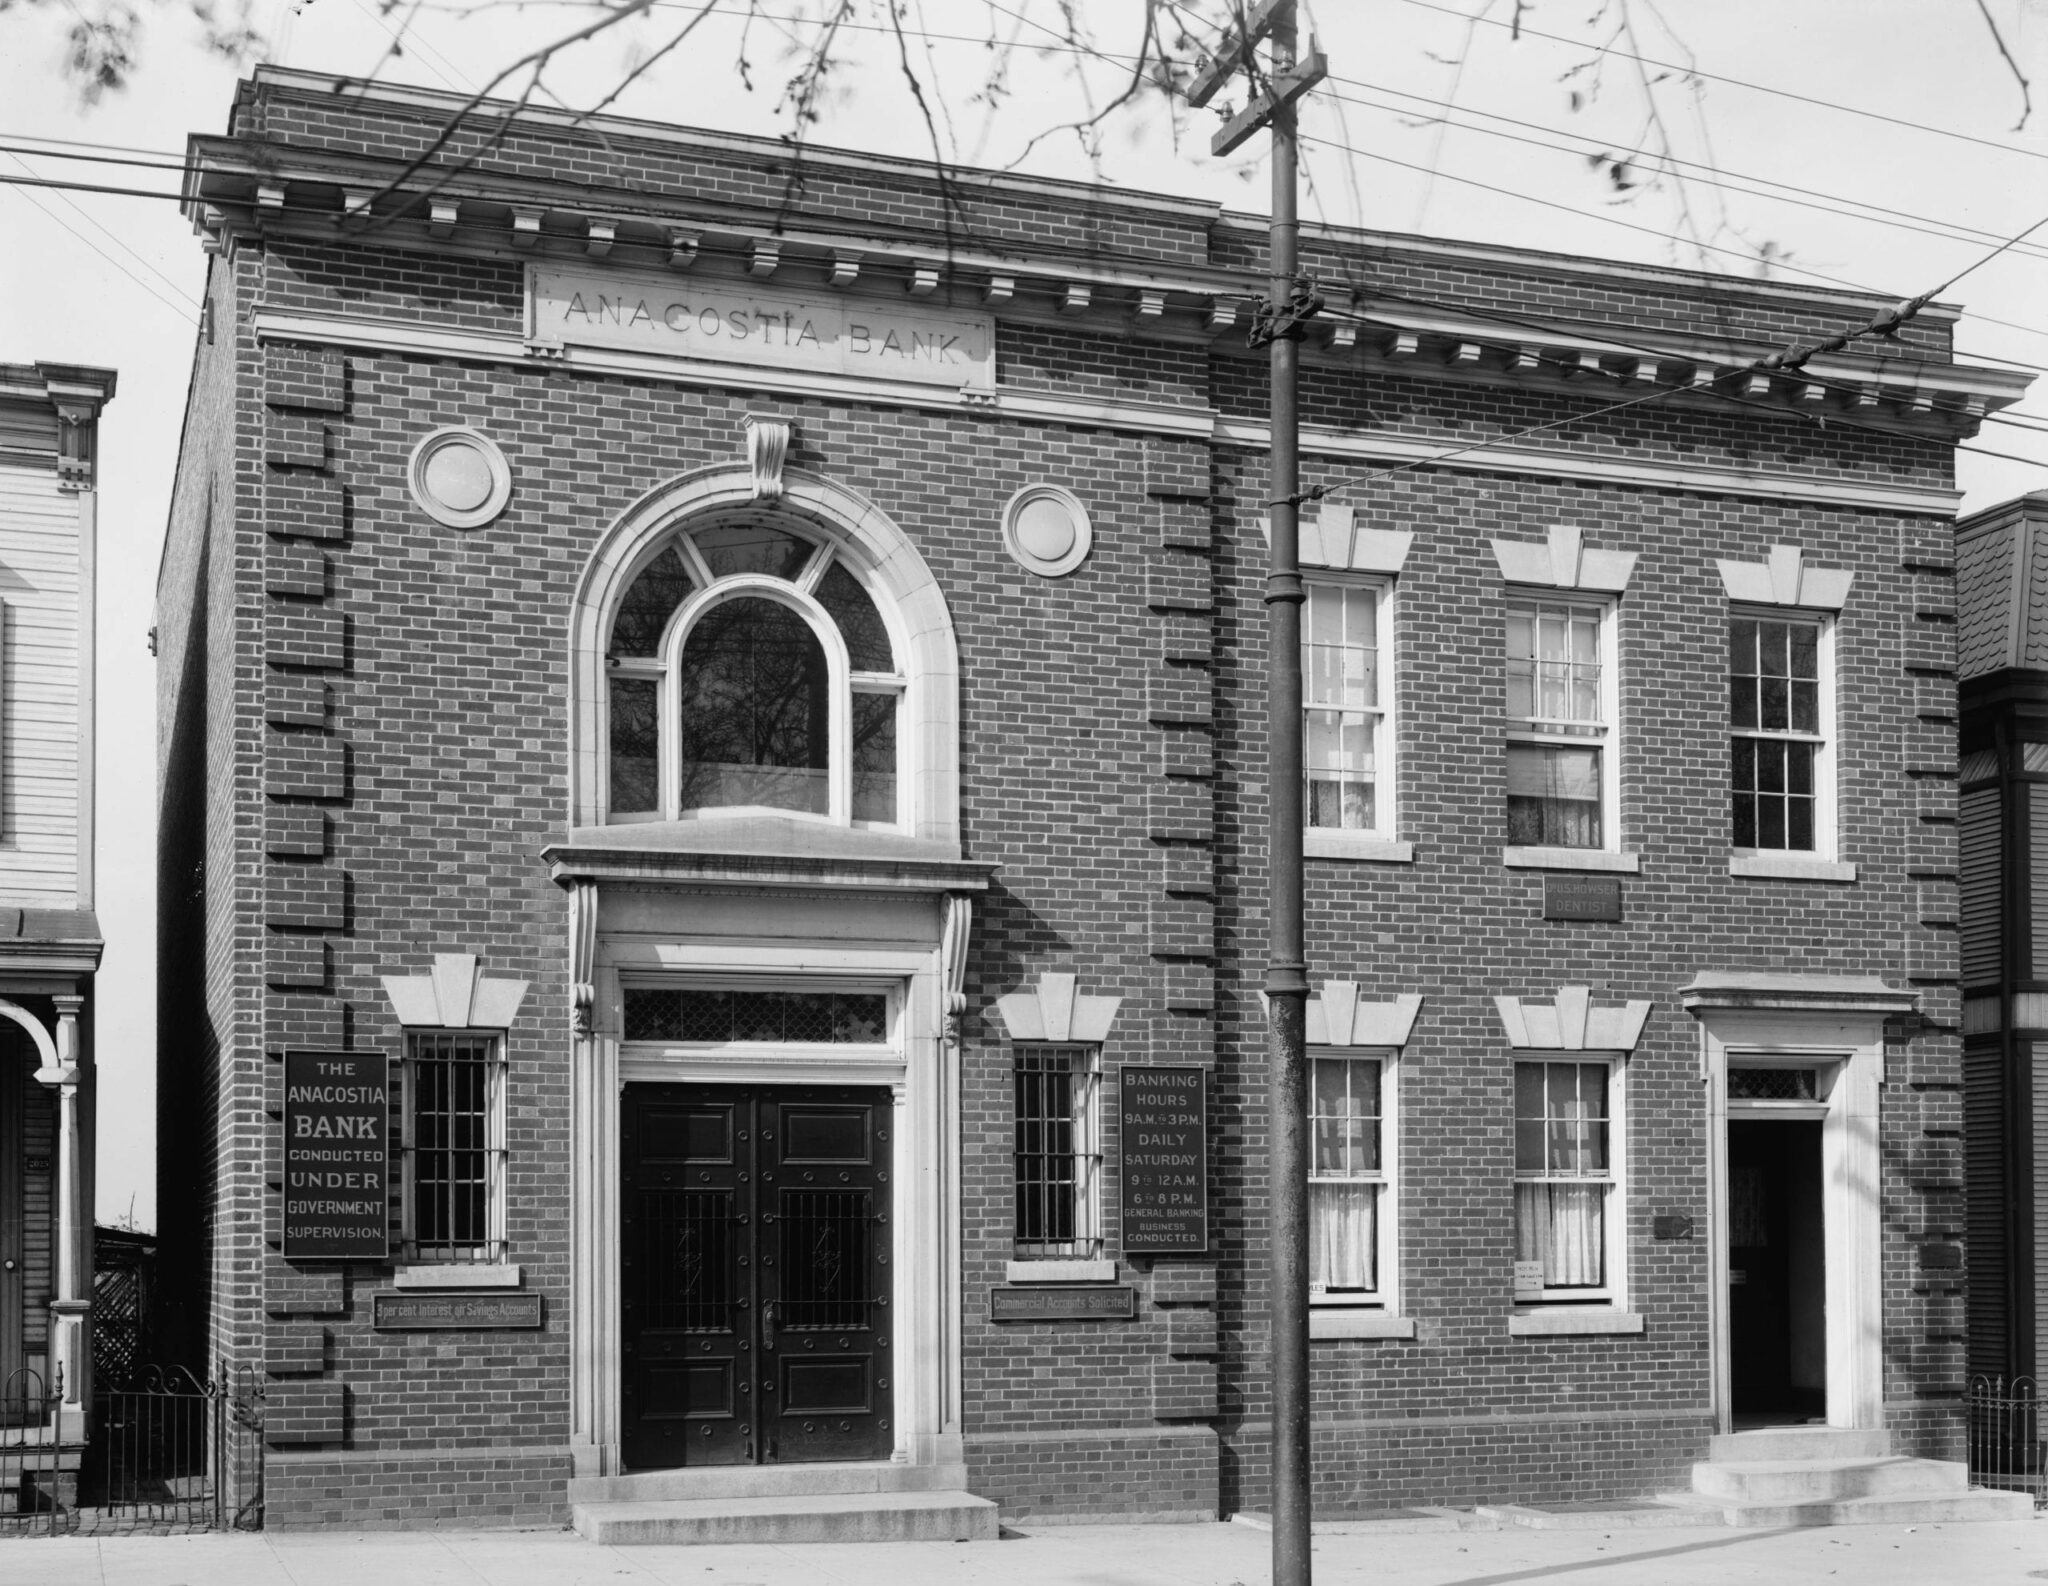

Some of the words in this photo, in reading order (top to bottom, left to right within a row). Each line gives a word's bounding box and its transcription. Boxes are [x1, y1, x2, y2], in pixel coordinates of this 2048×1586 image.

[564, 291, 821, 347] ANACOSTIA
[848, 323, 960, 365] BANK
[1556, 900, 1608, 912] DENTIST
[316, 1062, 356, 1076] THE
[1125, 1074, 1198, 1087] BANKING
[287, 1086, 386, 1104] ANACOSTIA
[1137, 1094, 1187, 1106] HOURS
[294, 1115, 378, 1139] BANK
[1139, 1133, 1187, 1146] DAILY
[289, 1149, 384, 1162] CONDUCTED
[1125, 1154, 1198, 1166] SATURDAY
[290, 1172, 380, 1189] UNDER
[1131, 1174, 1140, 1186] 9
[1134, 1193, 1142, 1204] 6
[1158, 1193, 1167, 1204] 8
[1171, 1193, 1197, 1205] P.M.
[288, 1200, 383, 1215] GOVERNMENT
[1124, 1208, 1165, 1218] GENERAL
[1166, 1208, 1204, 1218] BANKING
[287, 1226, 385, 1239] SUPERVISION.
[1140, 1223, 1186, 1231] BUSINESS
[994, 1296, 1045, 1309] Commercial
[1047, 1296, 1086, 1309] Accounts
[1088, 1295, 1129, 1308] Solicited
[376, 1303, 383, 1317] 3
[383, 1306, 398, 1321] per
[399, 1304, 417, 1317] cent
[419, 1303, 453, 1317] Interest
[466, 1303, 499, 1320] Savings
[500, 1303, 537, 1318] Accounts
